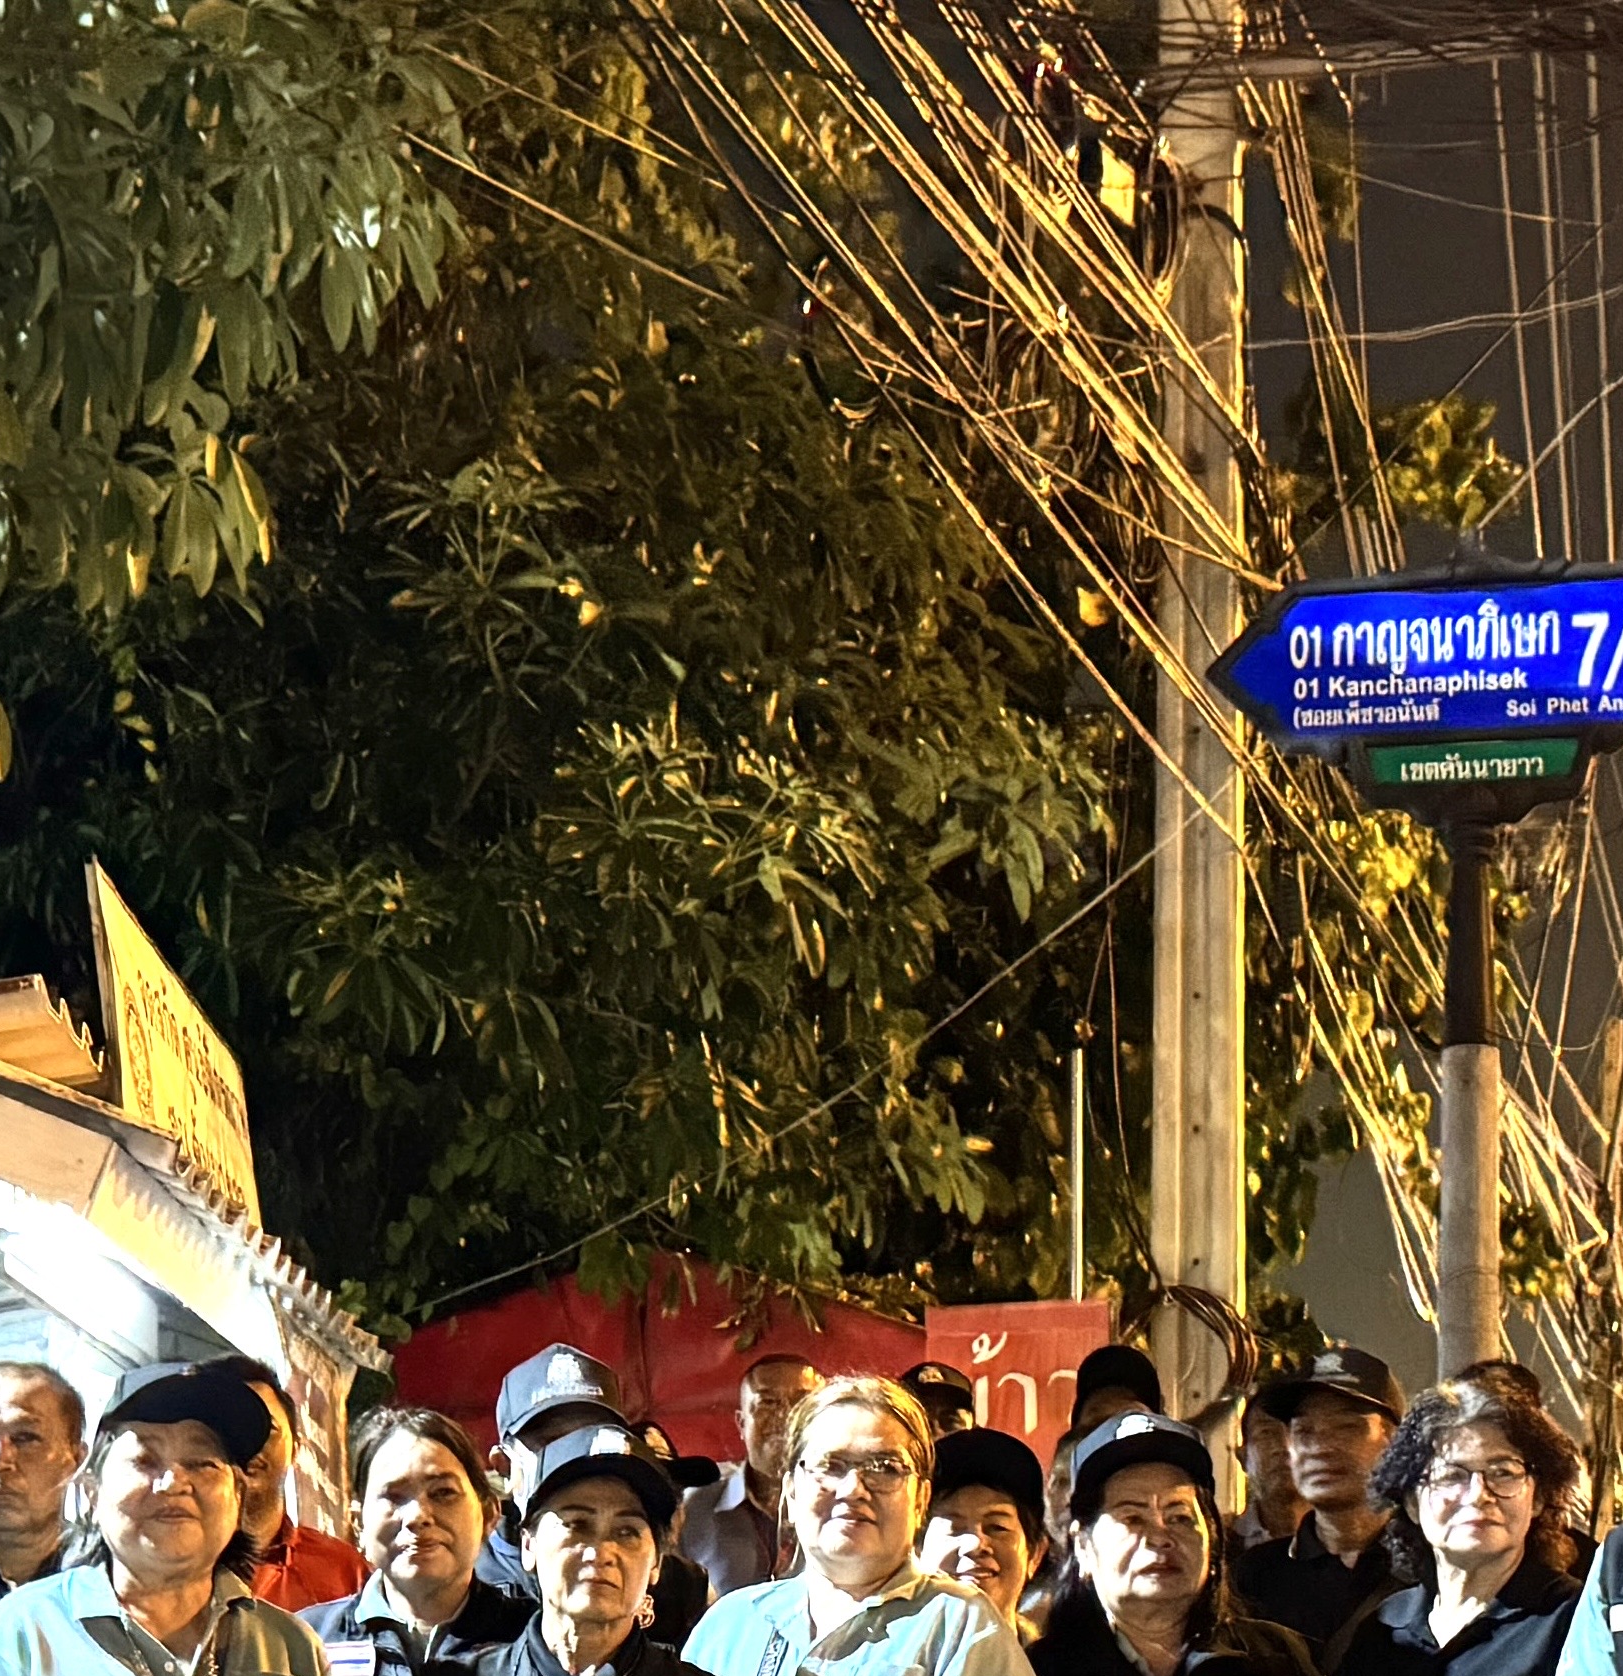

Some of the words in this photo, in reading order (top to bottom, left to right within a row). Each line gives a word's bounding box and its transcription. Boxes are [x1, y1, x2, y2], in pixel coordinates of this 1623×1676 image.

[1290, 625, 1322, 669] 01
[1333, 599, 1560, 675] กาญจนาภิเษก
[1293, 677, 1320, 700] 01
[1329, 667, 1528, 699] Kanchanaphisek
[1506, 699, 1537, 718] Soi
[1547, 697, 1589, 716] Phet
[1401, 752, 1544, 783] เขตคันนายาว
